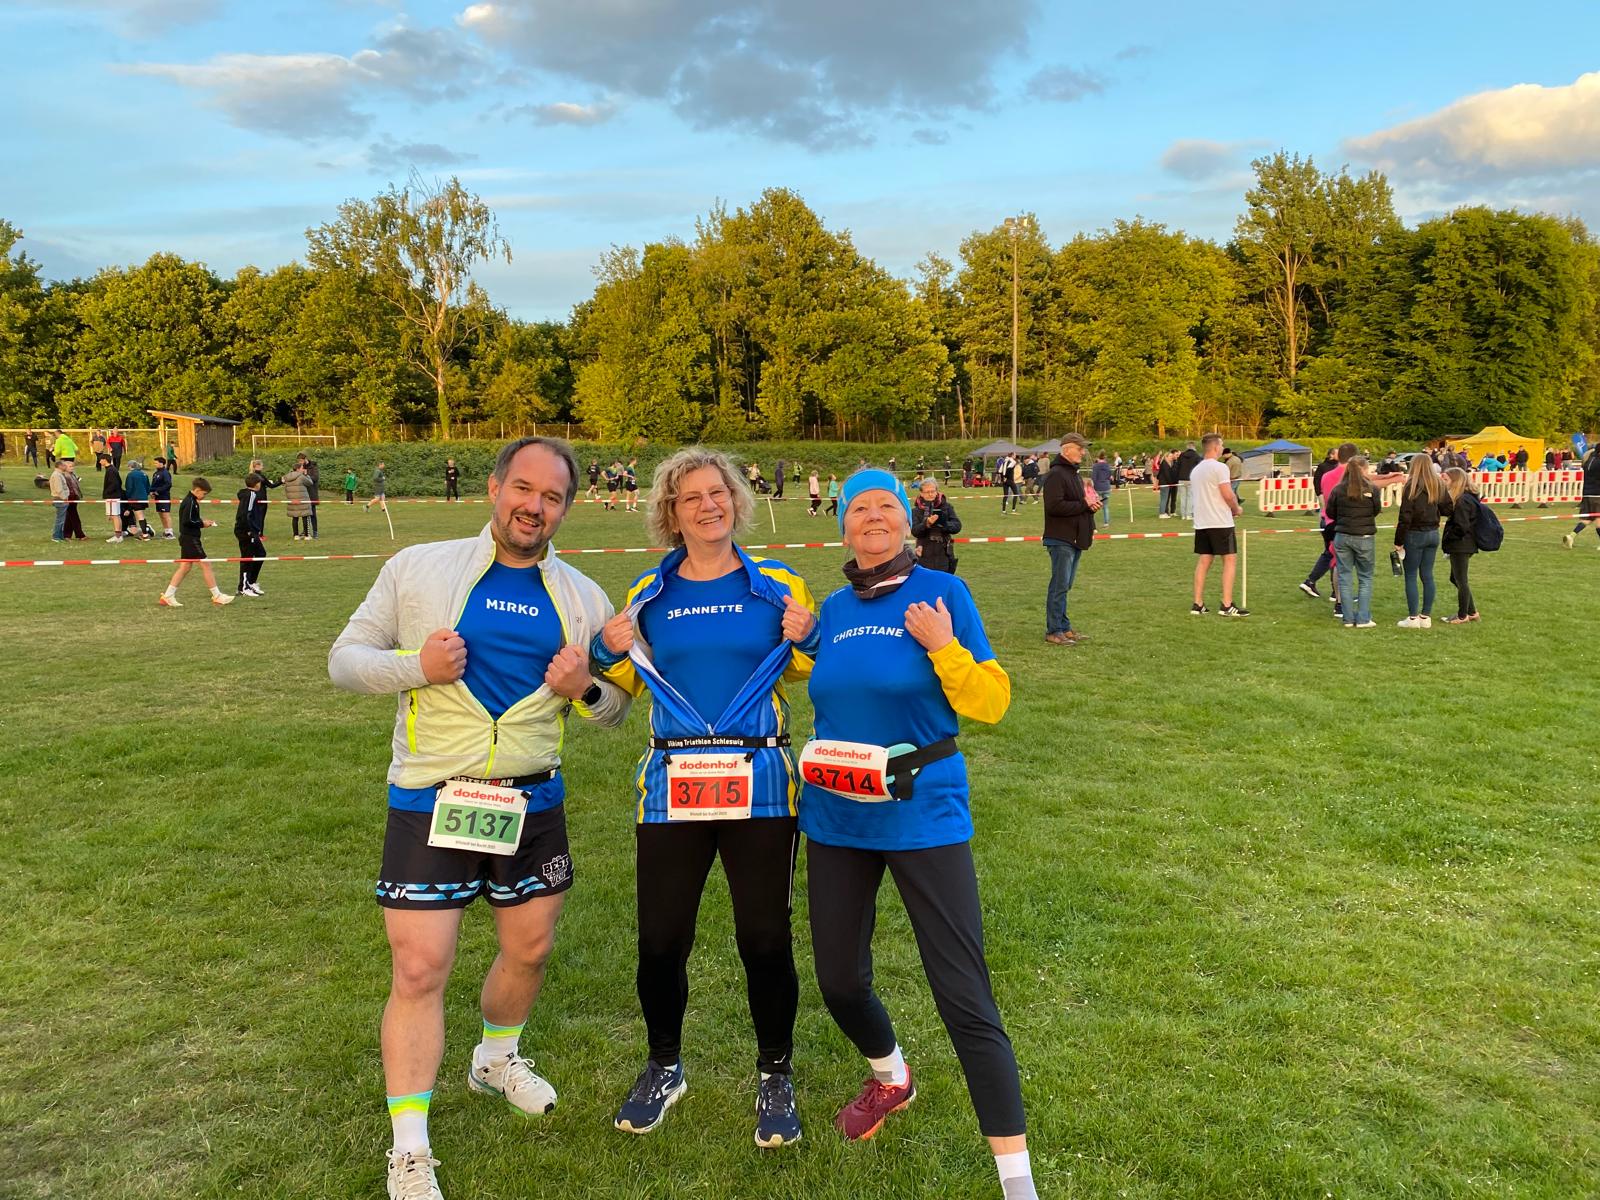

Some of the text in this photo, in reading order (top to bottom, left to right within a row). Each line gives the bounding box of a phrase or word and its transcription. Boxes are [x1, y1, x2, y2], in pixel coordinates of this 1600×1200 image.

[486, 598, 539, 617] MIRKO
[667, 604, 743, 620] JEANNETTE
[832, 625, 904, 644] CHRISTIANE
[667, 738, 744, 748] Viking Triathlon Schleswig
[814, 746, 873, 761] dodenhof
[679, 760, 738, 770] dodenhof
[810, 767, 876, 794] 3714
[453, 788, 516, 804] dodenhof
[677, 780, 741, 805] 3715
[444, 808, 514, 839] 5137
